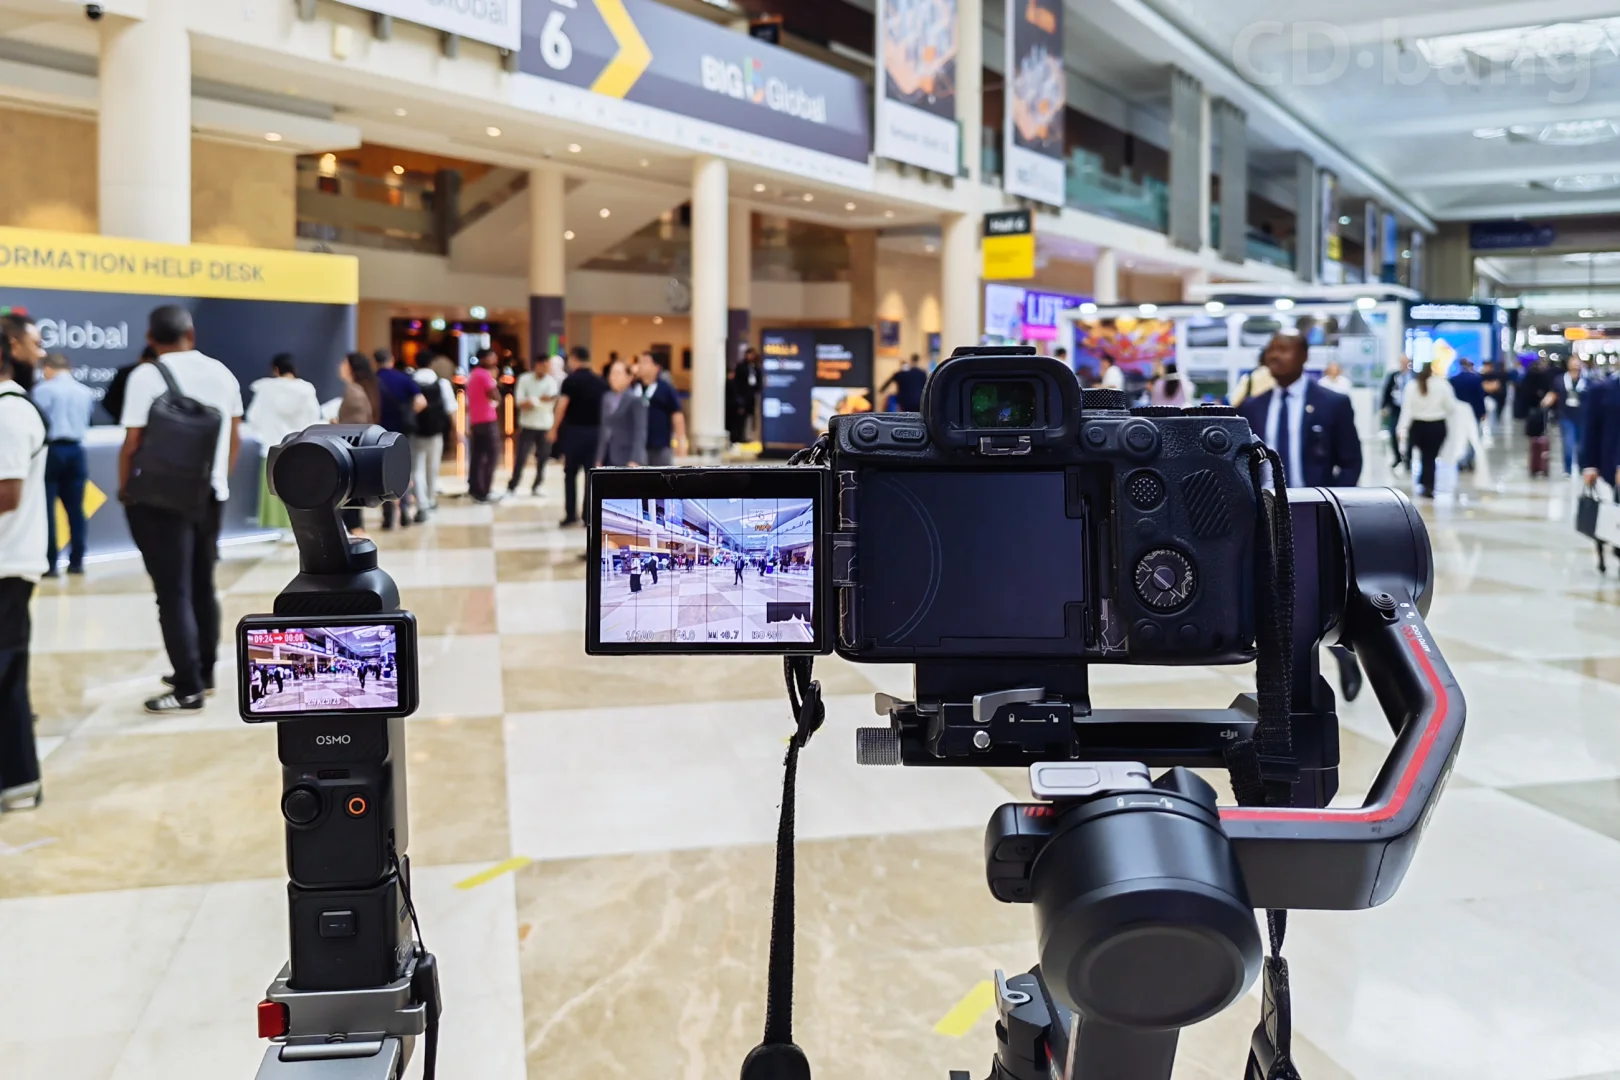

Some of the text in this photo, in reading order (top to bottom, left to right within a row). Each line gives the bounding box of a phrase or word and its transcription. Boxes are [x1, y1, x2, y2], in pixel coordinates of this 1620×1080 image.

[539, 10, 573, 71] 6
[144, 254, 202, 279] HELP
[210, 260, 265, 283] DESK
[37, 318, 128, 350] Global
[862, 427, 875, 435] C3
[894, 430, 921, 438] MENU
[284, 633, 304, 642] 00:00
[316, 735, 351, 745] OSMO
